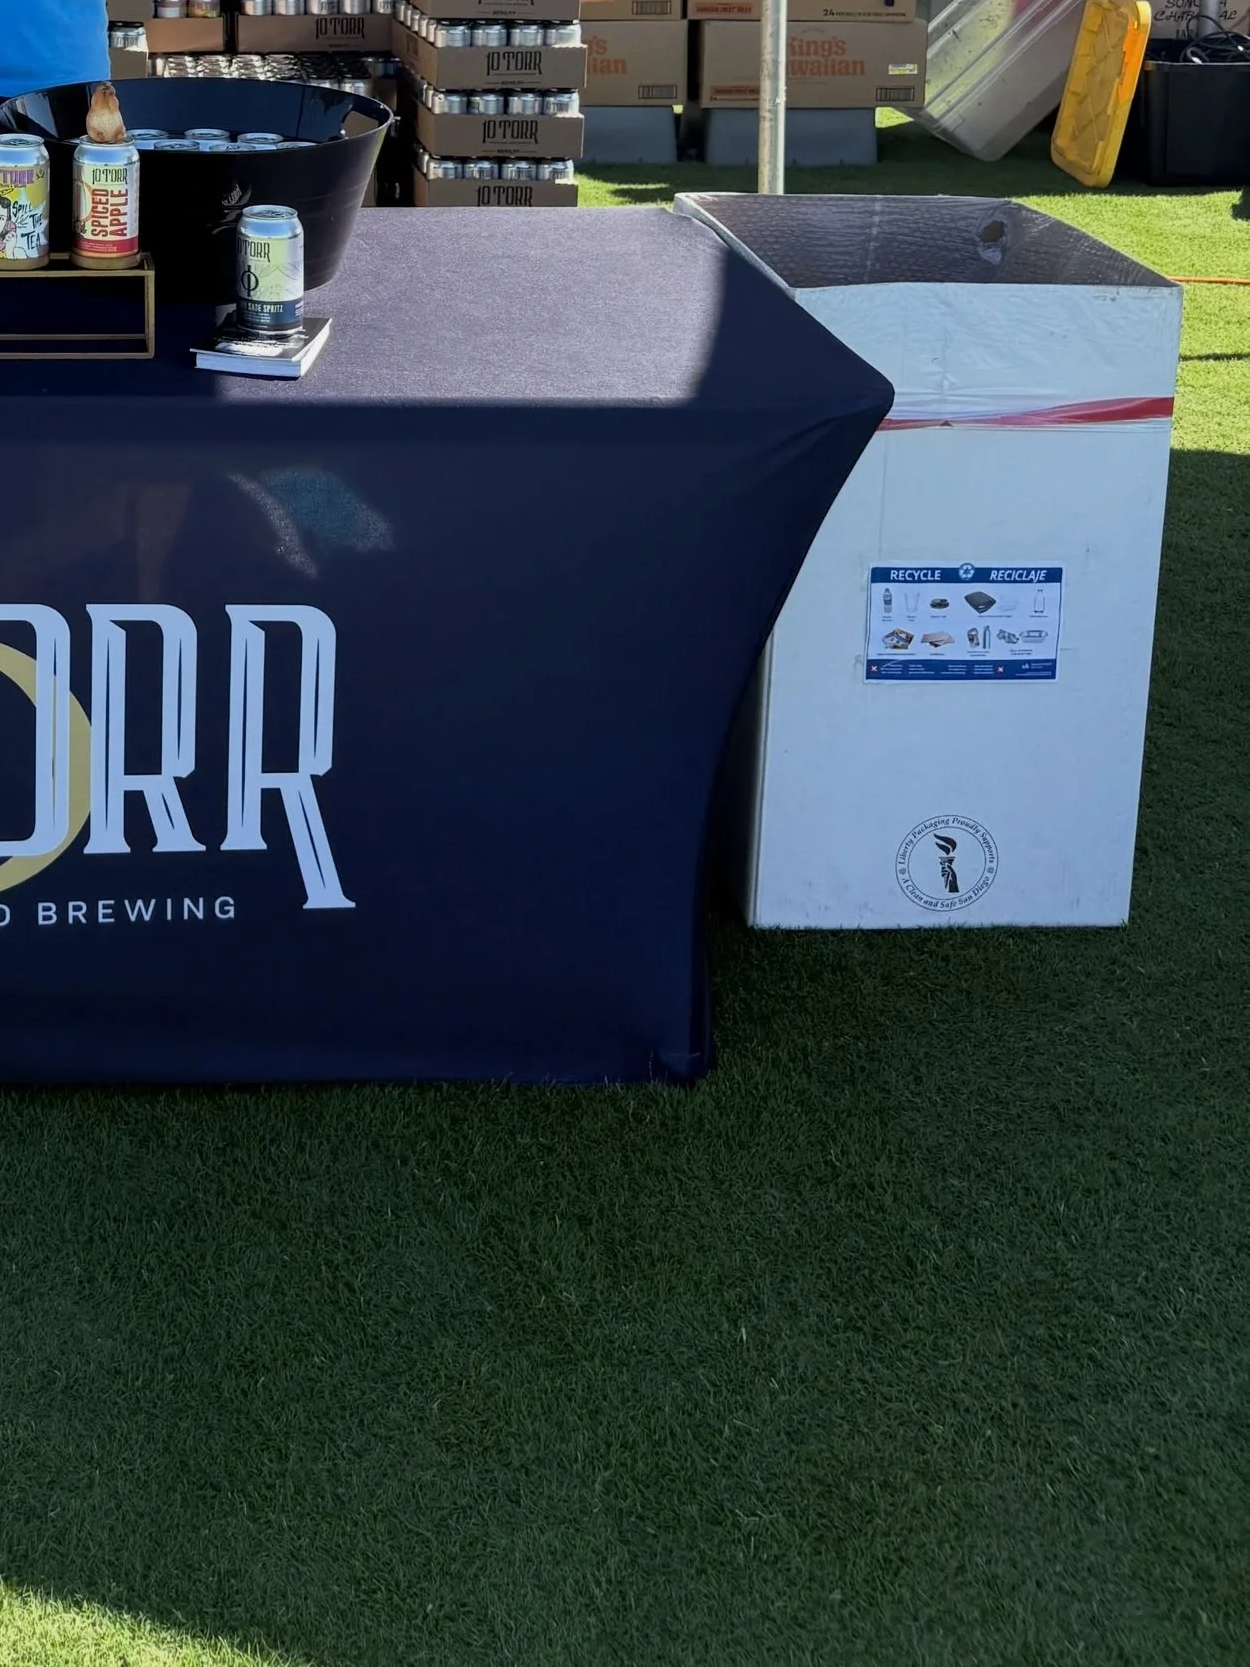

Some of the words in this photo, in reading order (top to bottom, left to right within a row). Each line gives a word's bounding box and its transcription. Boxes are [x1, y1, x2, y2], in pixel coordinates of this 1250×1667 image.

[316, 17, 327, 39] 10
[330, 17, 365, 38] TORR
[486, 51, 500, 76] 10
[502, 51, 542, 75] TORR
[482, 120, 496, 143] 10
[499, 120, 539, 144] TORR
[93, 168, 102, 185] 10
[102, 167, 128, 185] TORR
[476, 185, 491, 207] 10
[493, 185, 533, 207] TORR
[91, 188, 109, 237] SPICED
[109, 188, 128, 237] APPLE
[242, 239, 271, 263] TORR
[263, 304, 283, 313] SPRITZ
[890, 569, 941, 581] RECYCLE
[989, 569, 1047, 583] RECICLAJE
[898, 838, 915, 865] Liberty
[911, 818, 950, 840] Packaging
[951, 817, 982, 835] Proudly
[979, 831, 996, 864] Supports
[901, 877, 910, 885] A
[972, 875, 990, 897] Diego
[905, 884, 924, 902] Clean
[923, 898, 939, 908] and
[958, 894, 973, 905] San
[37, 895, 237, 927] BREWING
[939, 901, 957, 909] Safe
